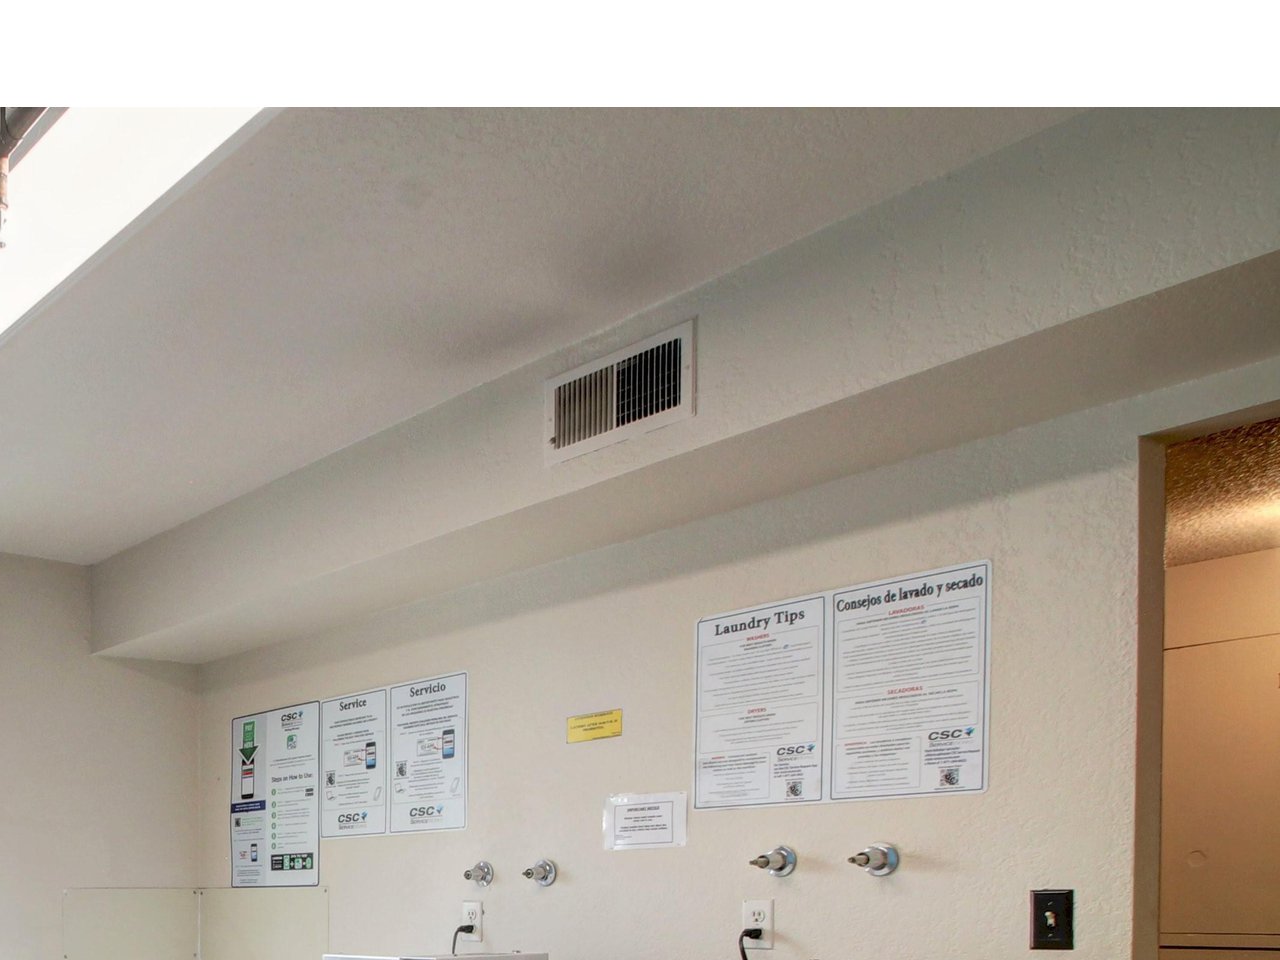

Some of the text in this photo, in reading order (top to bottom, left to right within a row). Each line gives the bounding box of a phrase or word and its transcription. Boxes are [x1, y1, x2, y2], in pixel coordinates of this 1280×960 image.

[836, 573, 983, 612] Consejos de lavado y secado
[888, 605, 925, 616] LAVADORAS
[714, 610, 805, 636] Laundry Tips
[409, 682, 446, 698] Servicio
[887, 685, 923, 695] SECADORAS
[339, 698, 367, 711] Service
[281, 711, 298, 722] CSC
[928, 729, 963, 741] CSC
[776, 745, 805, 756] CSC
[409, 806, 435, 817] CSC
[338, 813, 360, 823] CSC
